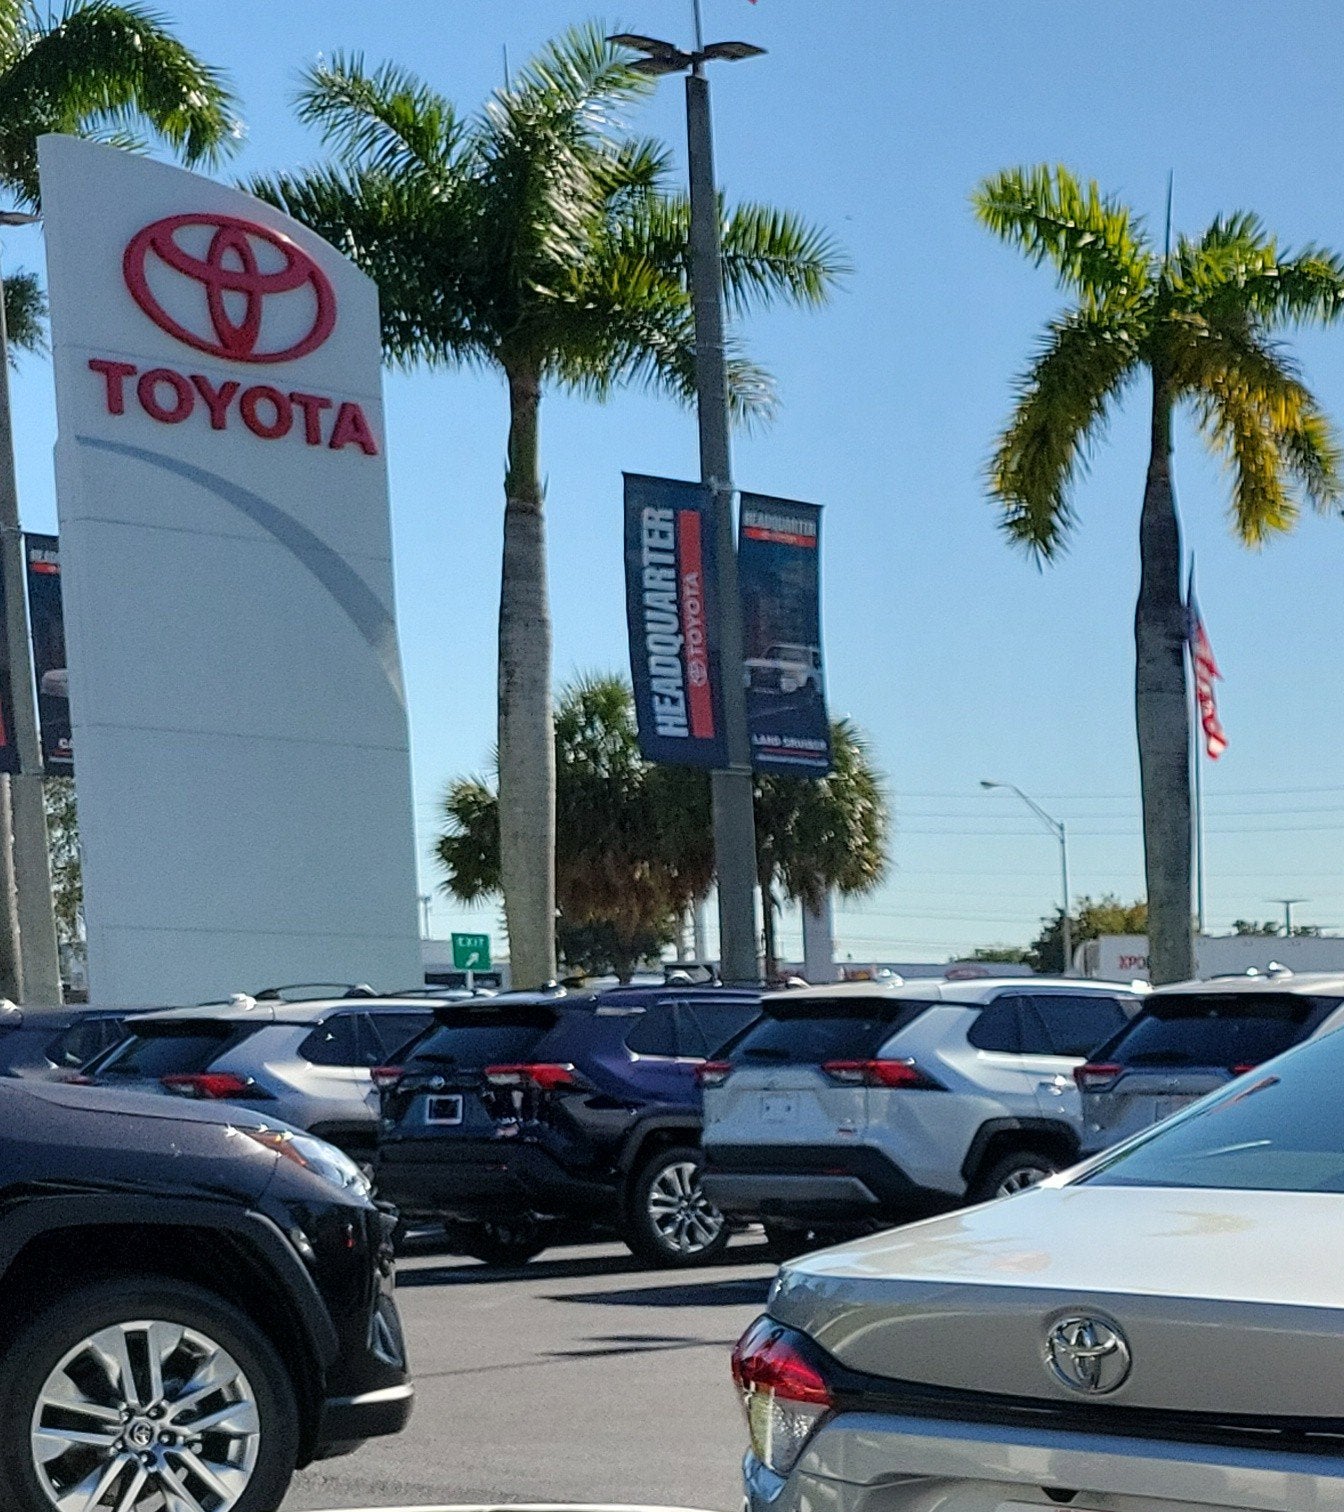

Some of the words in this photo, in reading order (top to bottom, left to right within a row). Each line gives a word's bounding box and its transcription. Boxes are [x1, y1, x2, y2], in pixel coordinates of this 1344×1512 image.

[89, 358, 378, 456] TOYOTA
[641, 506, 689, 737] HEADQUARTER
[682, 572, 705, 657] TOYOTA
[457, 936, 485, 948] EXIT
